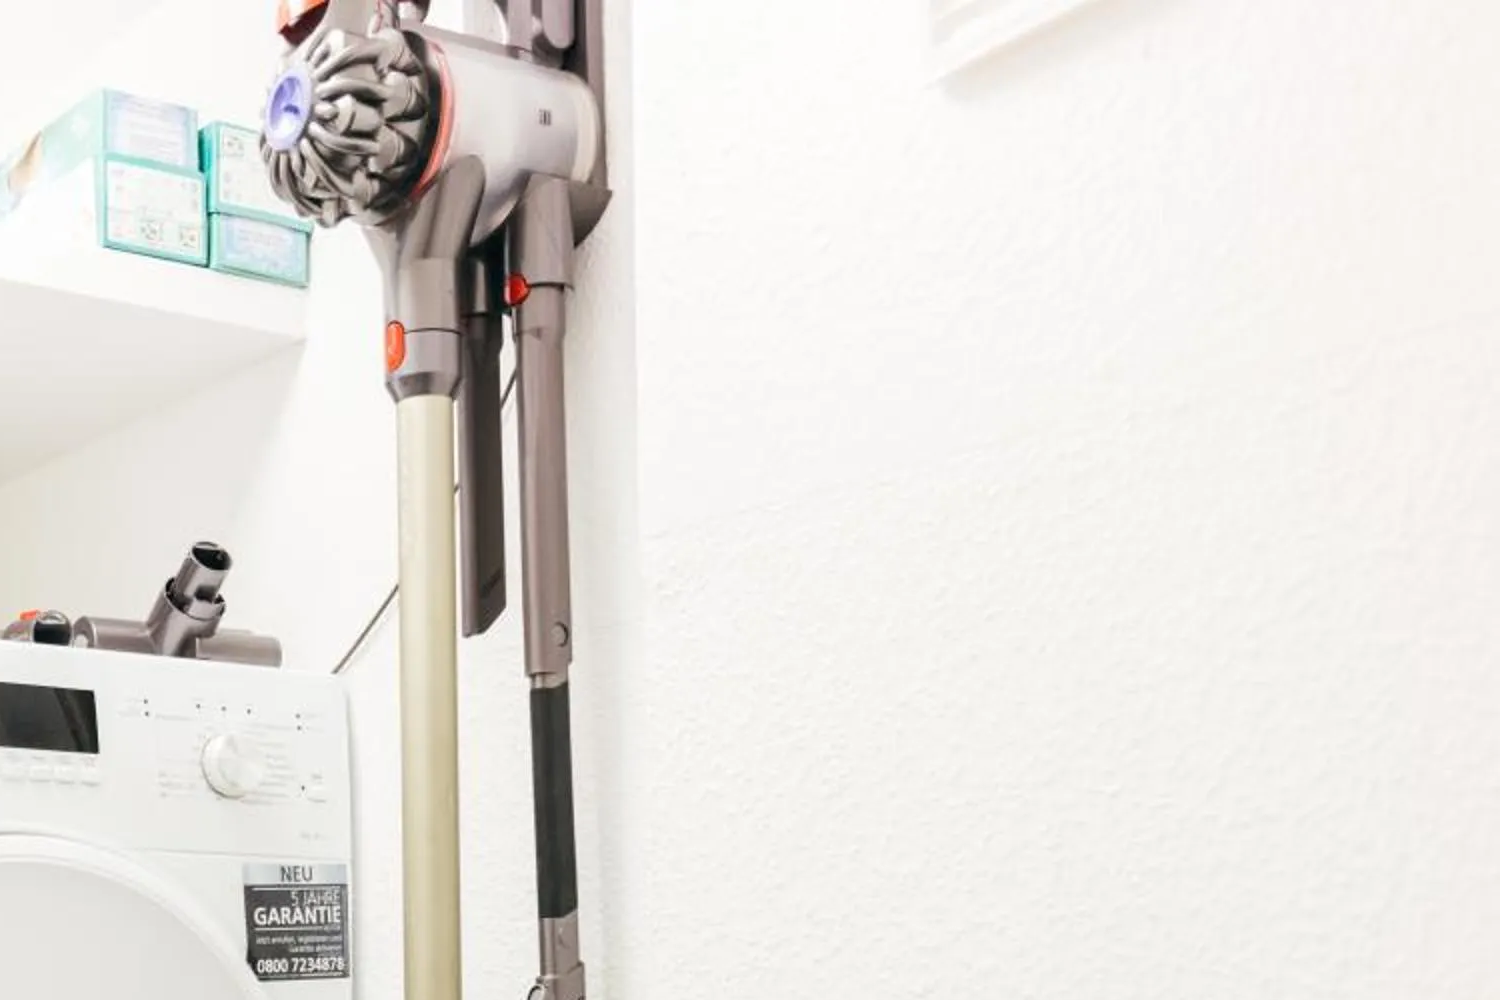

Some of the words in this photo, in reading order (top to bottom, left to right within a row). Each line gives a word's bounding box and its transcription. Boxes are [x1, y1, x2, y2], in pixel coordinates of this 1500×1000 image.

[280, 865, 314, 883] NEU
[302, 888, 341, 906] JAHRE
[253, 906, 341, 926] GARANTIE
[257, 958, 289, 974] 0800
